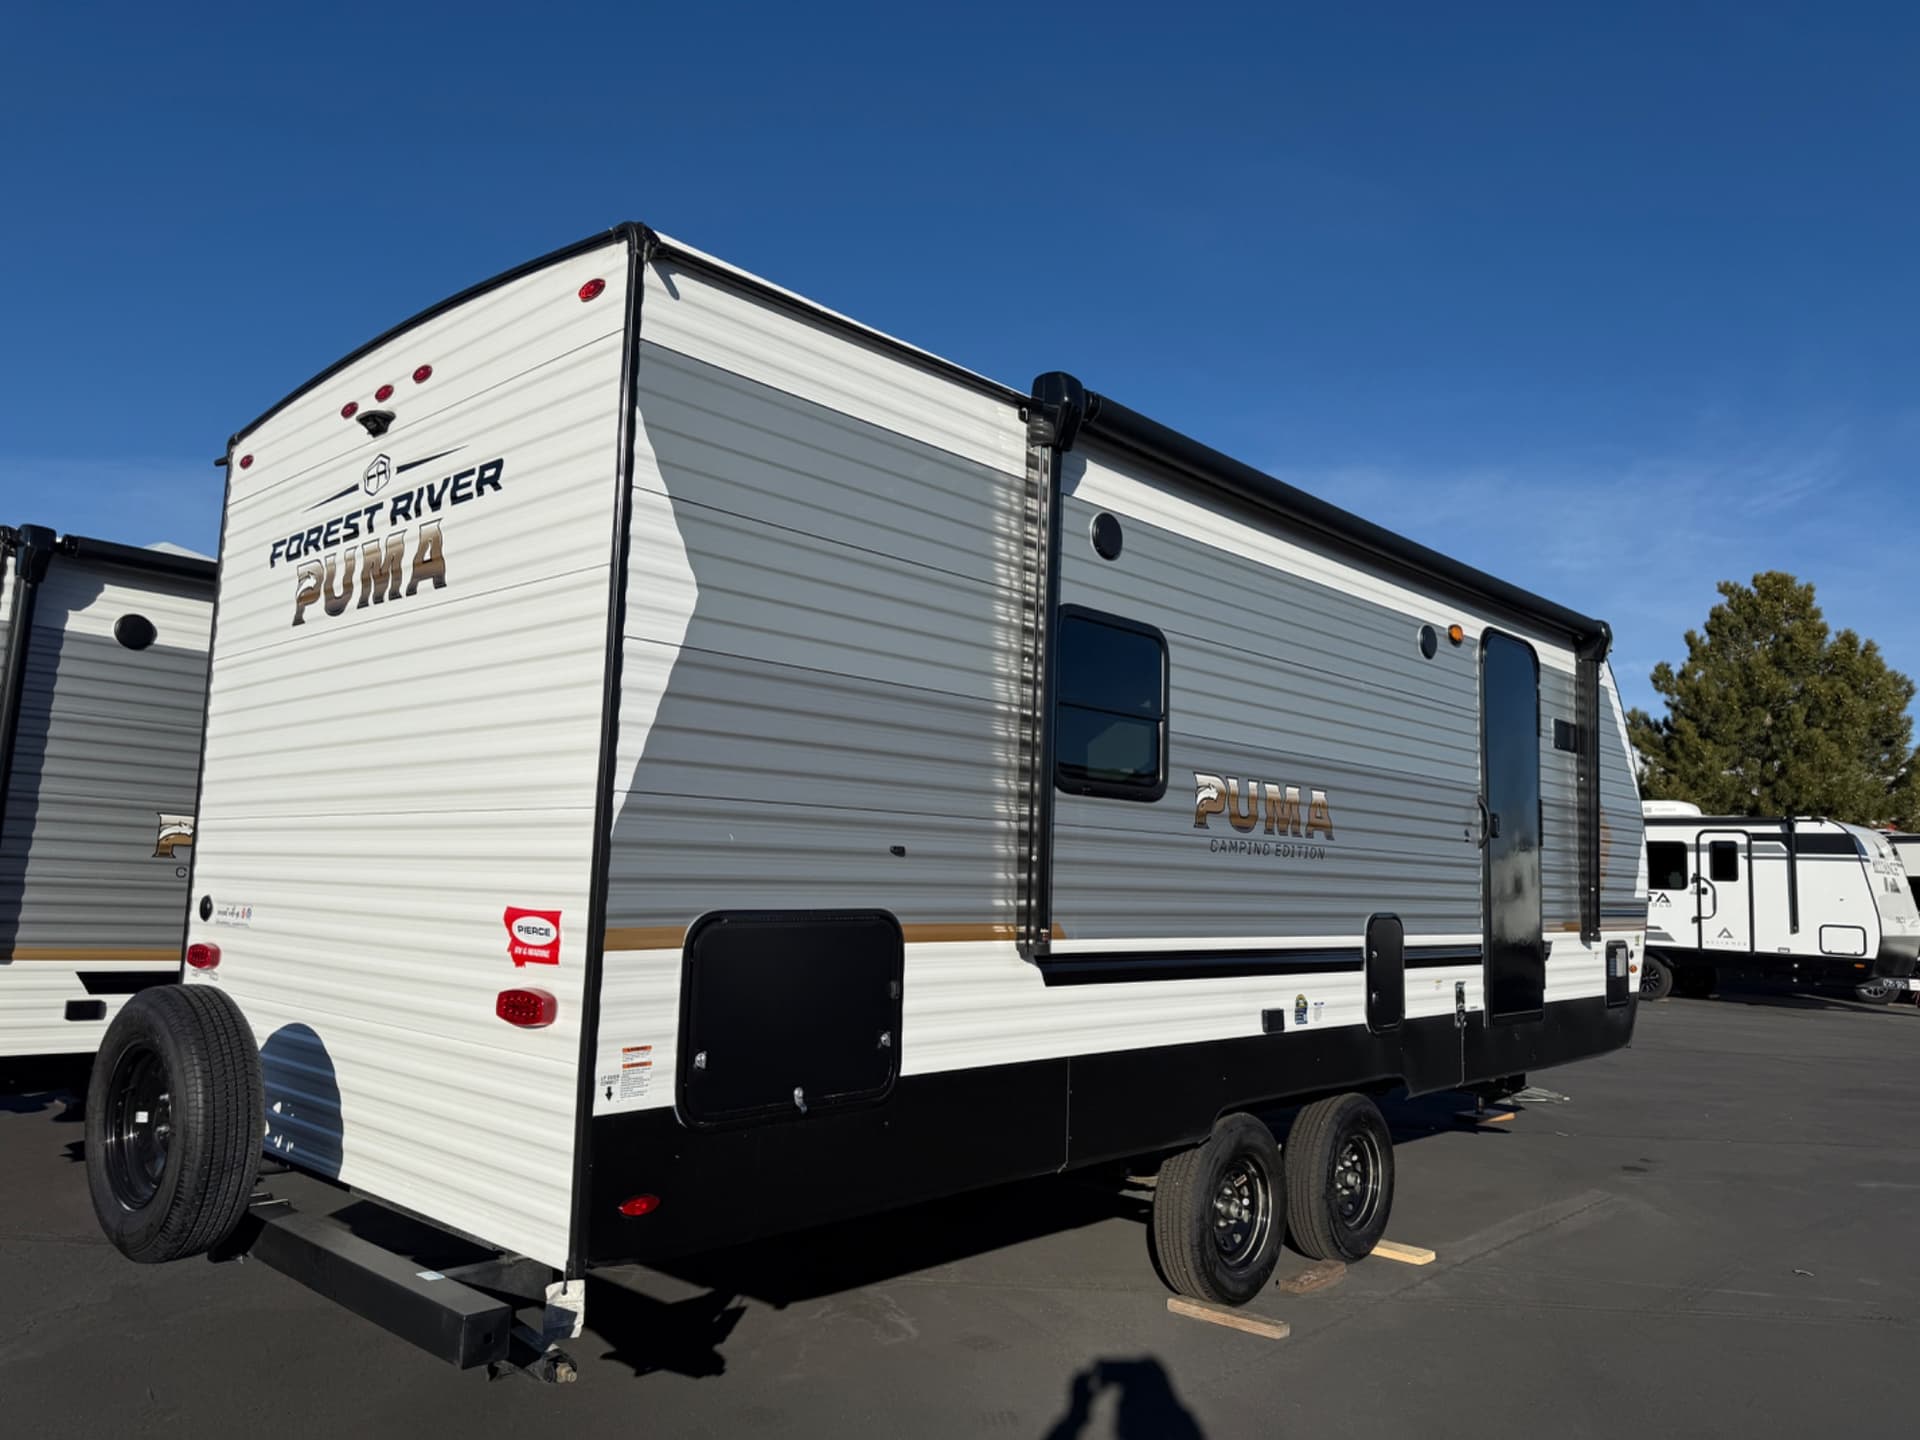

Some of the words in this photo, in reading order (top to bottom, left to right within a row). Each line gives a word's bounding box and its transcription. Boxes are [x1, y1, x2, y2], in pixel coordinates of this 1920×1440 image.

[269, 502, 384, 569] FOREST
[389, 458, 504, 527] RIVER
[292, 518, 448, 627] PUMA
[1193, 771, 1335, 841] PUMA
[1209, 838, 1271, 857] CAMPING
[1275, 845, 1326, 861] EDITION
[517, 924, 551, 937] PIERCE
